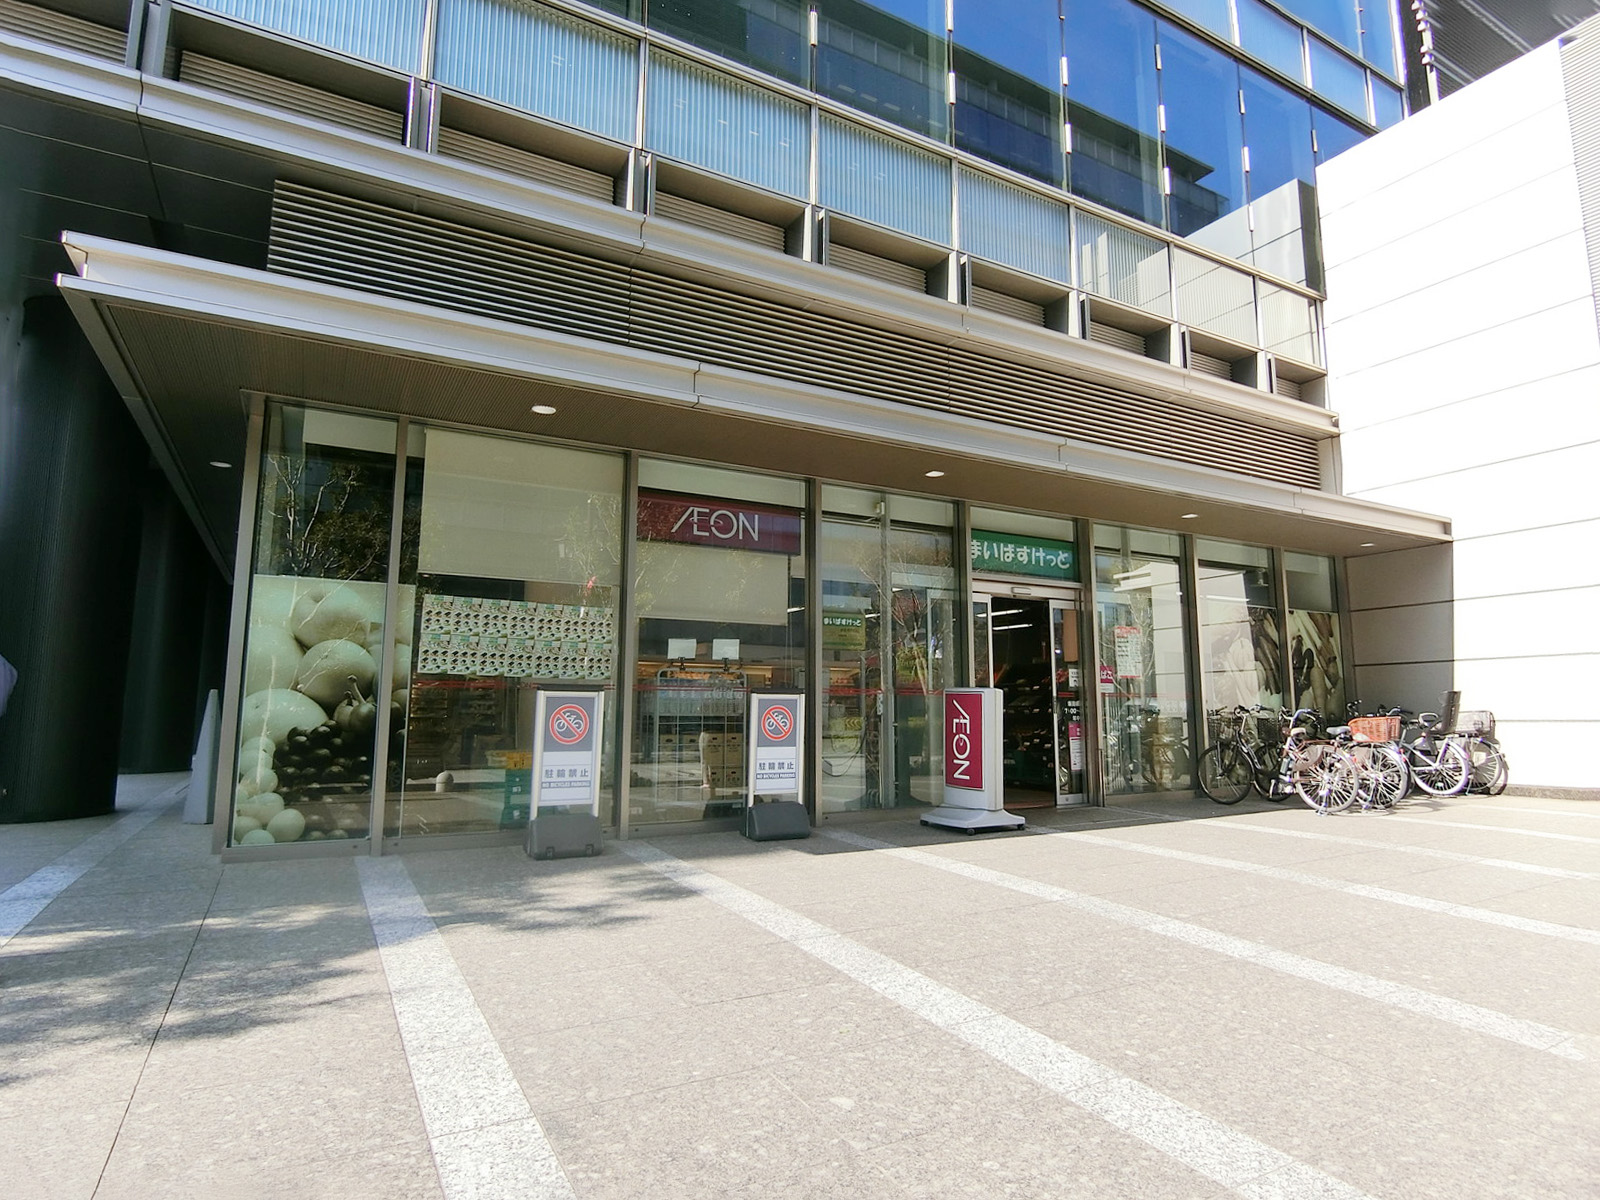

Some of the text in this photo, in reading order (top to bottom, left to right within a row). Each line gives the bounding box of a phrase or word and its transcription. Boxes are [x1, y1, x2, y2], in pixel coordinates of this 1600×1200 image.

[970, 540, 1070, 569] まいばすけっと
[758, 761, 794, 770] 駐輪禁止
[545, 768, 589, 779] 駐輪禁止
